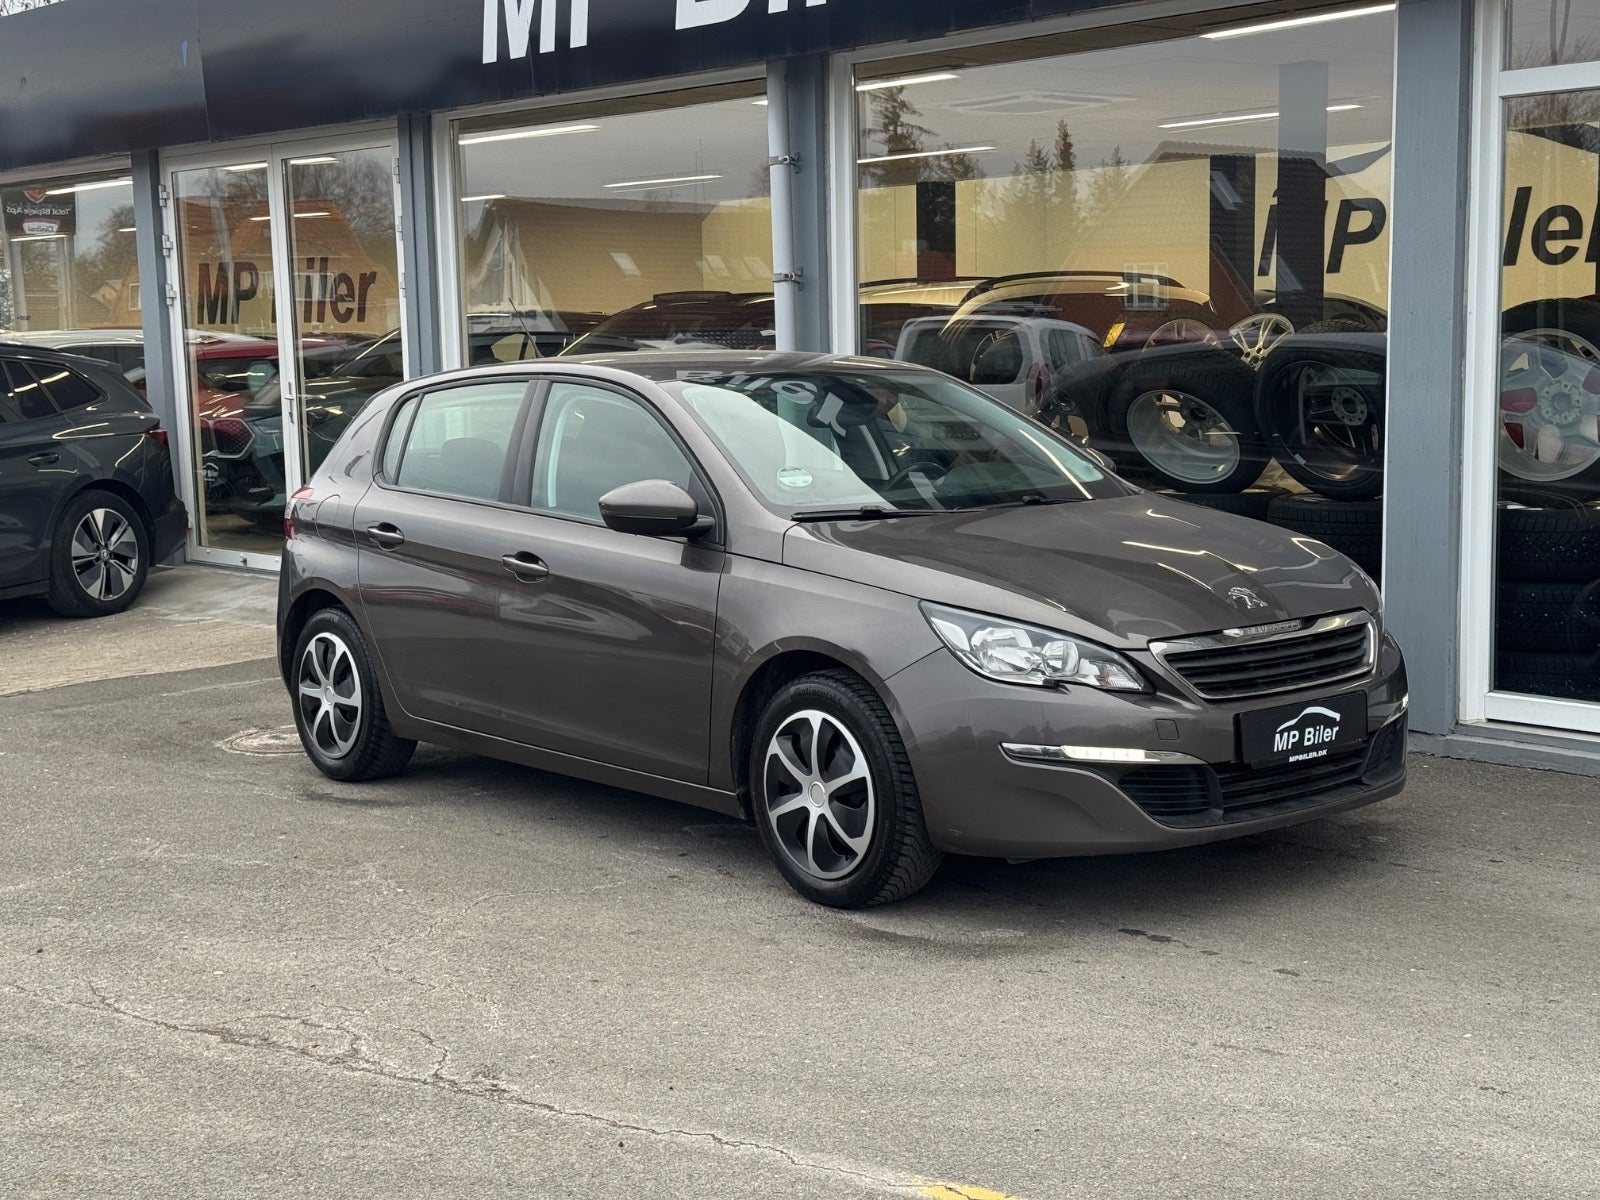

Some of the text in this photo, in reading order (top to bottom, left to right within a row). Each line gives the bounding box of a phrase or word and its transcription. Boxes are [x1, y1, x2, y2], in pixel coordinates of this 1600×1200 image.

[1257, 197, 1387, 277] P
[197, 256, 377, 324] MP iler
[1274, 725, 1339, 752] MP Biler
[1289, 749, 1327, 762] MPBILER.DK
